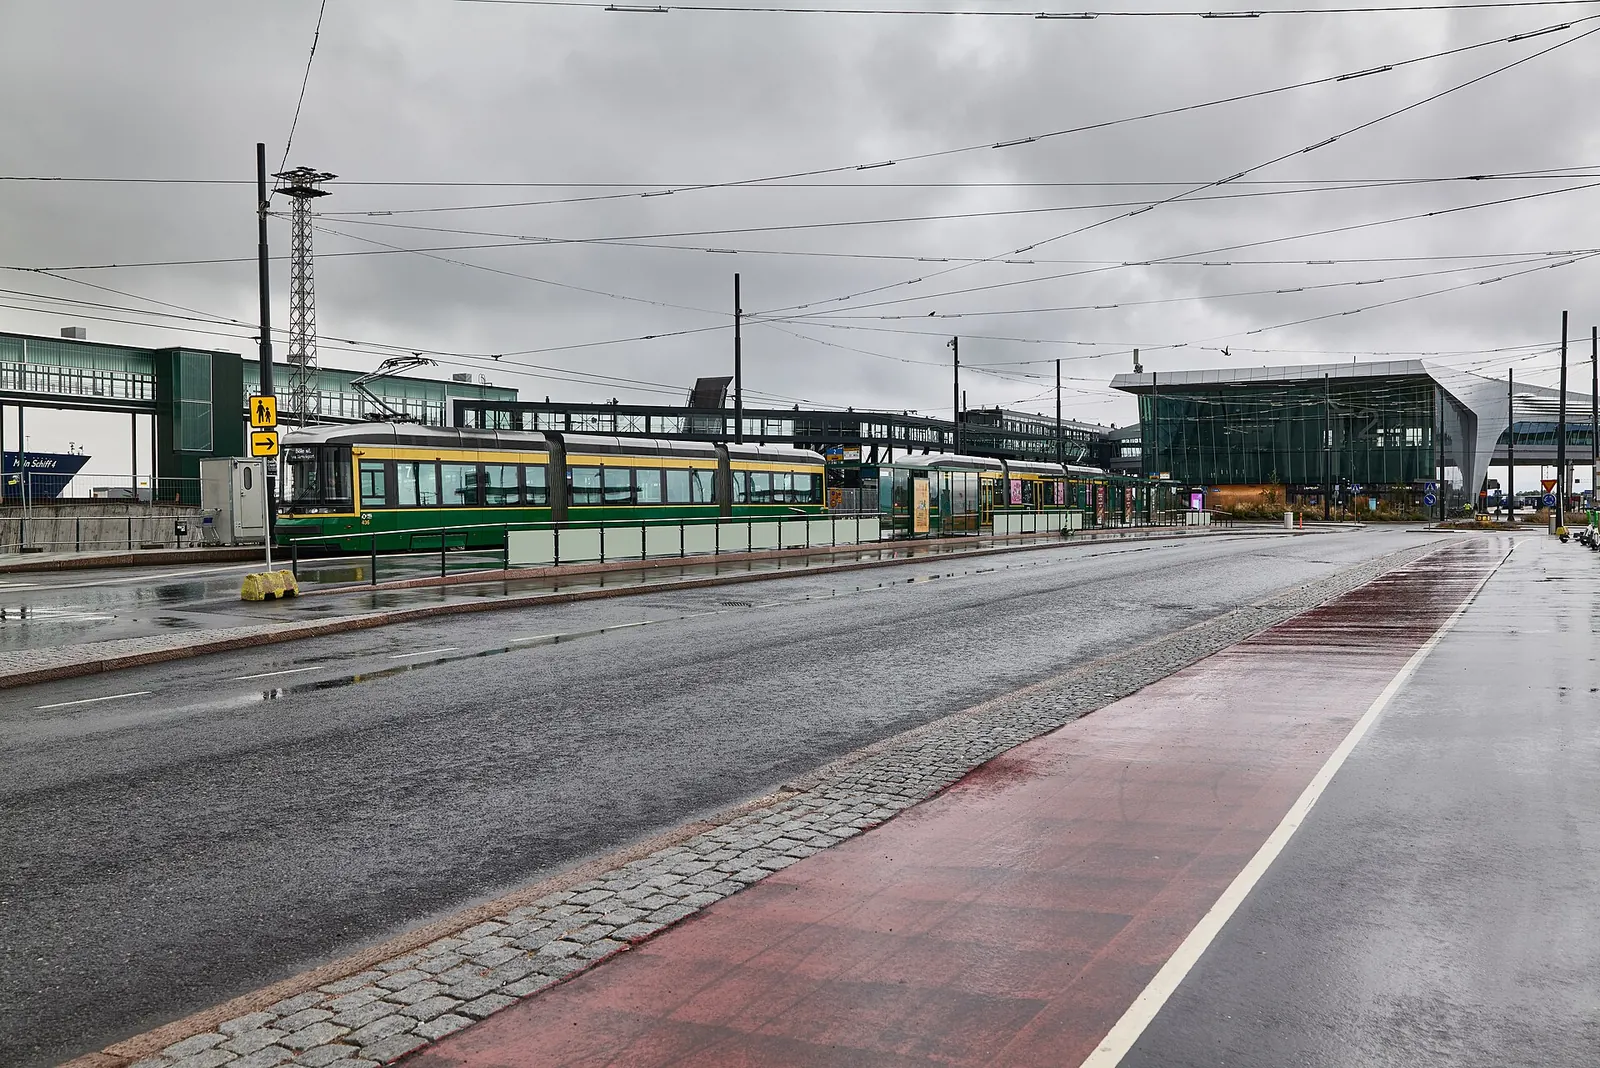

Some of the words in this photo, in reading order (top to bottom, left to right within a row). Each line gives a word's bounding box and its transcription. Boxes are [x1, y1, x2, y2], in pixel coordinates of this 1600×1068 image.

[13, 459, 30, 467] Min
[31, 459, 53, 468] Schiff
[51, 460, 57, 468] 4
[405, 466, 412, 478] 7
